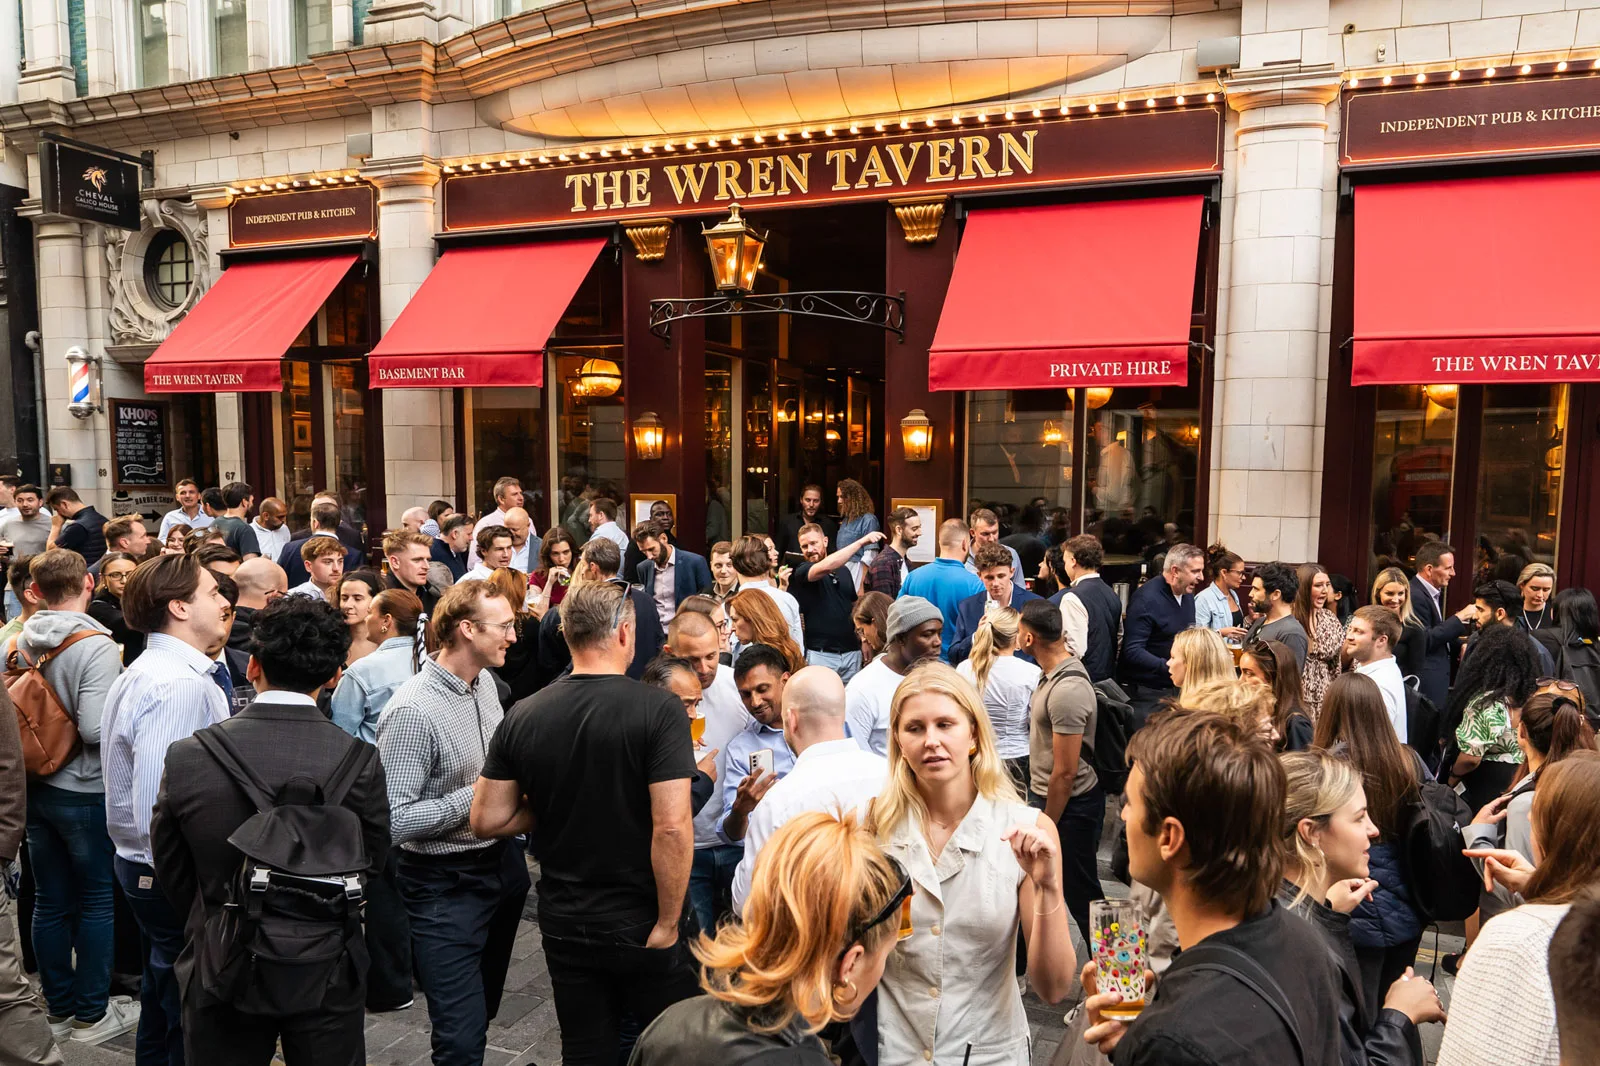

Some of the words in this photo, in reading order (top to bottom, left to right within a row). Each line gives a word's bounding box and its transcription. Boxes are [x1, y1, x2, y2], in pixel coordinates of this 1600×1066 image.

[1380, 113, 1488, 134] INDEPENDENT
[1491, 111, 1522, 125] PUB
[1525, 110, 1538, 122] &
[1541, 105, 1600, 121] KITCHE
[565, 167, 652, 212] THE
[663, 152, 812, 204] WREN
[826, 129, 1039, 191] TAVERN
[79, 189, 114, 203] CHEVAL
[75, 196, 98, 206] CALICO
[98, 201, 119, 211] HOUSE
[245, 212, 296, 225] INDEPENDENT
[297, 210, 313, 220] PUB
[313, 210, 320, 219] &
[321, 207, 356, 218] KITCHEN
[1050, 362, 1123, 377] PRIVATE
[1127, 360, 1171, 375] HIRE
[1432, 356, 1475, 372] THE
[1480, 355, 1548, 371] WREN
[1553, 354, 1600, 370] TAV
[152, 375, 172, 385] THE
[173, 374, 203, 385] WREN
[203, 373, 243, 385] TAVERN
[379, 367, 439, 380] BASEMENT
[441, 367, 465, 379] BAR
[119, 406, 158, 420] KHOPS
[225, 471, 236, 481] 67
[135, 495, 158, 505] BARBER
